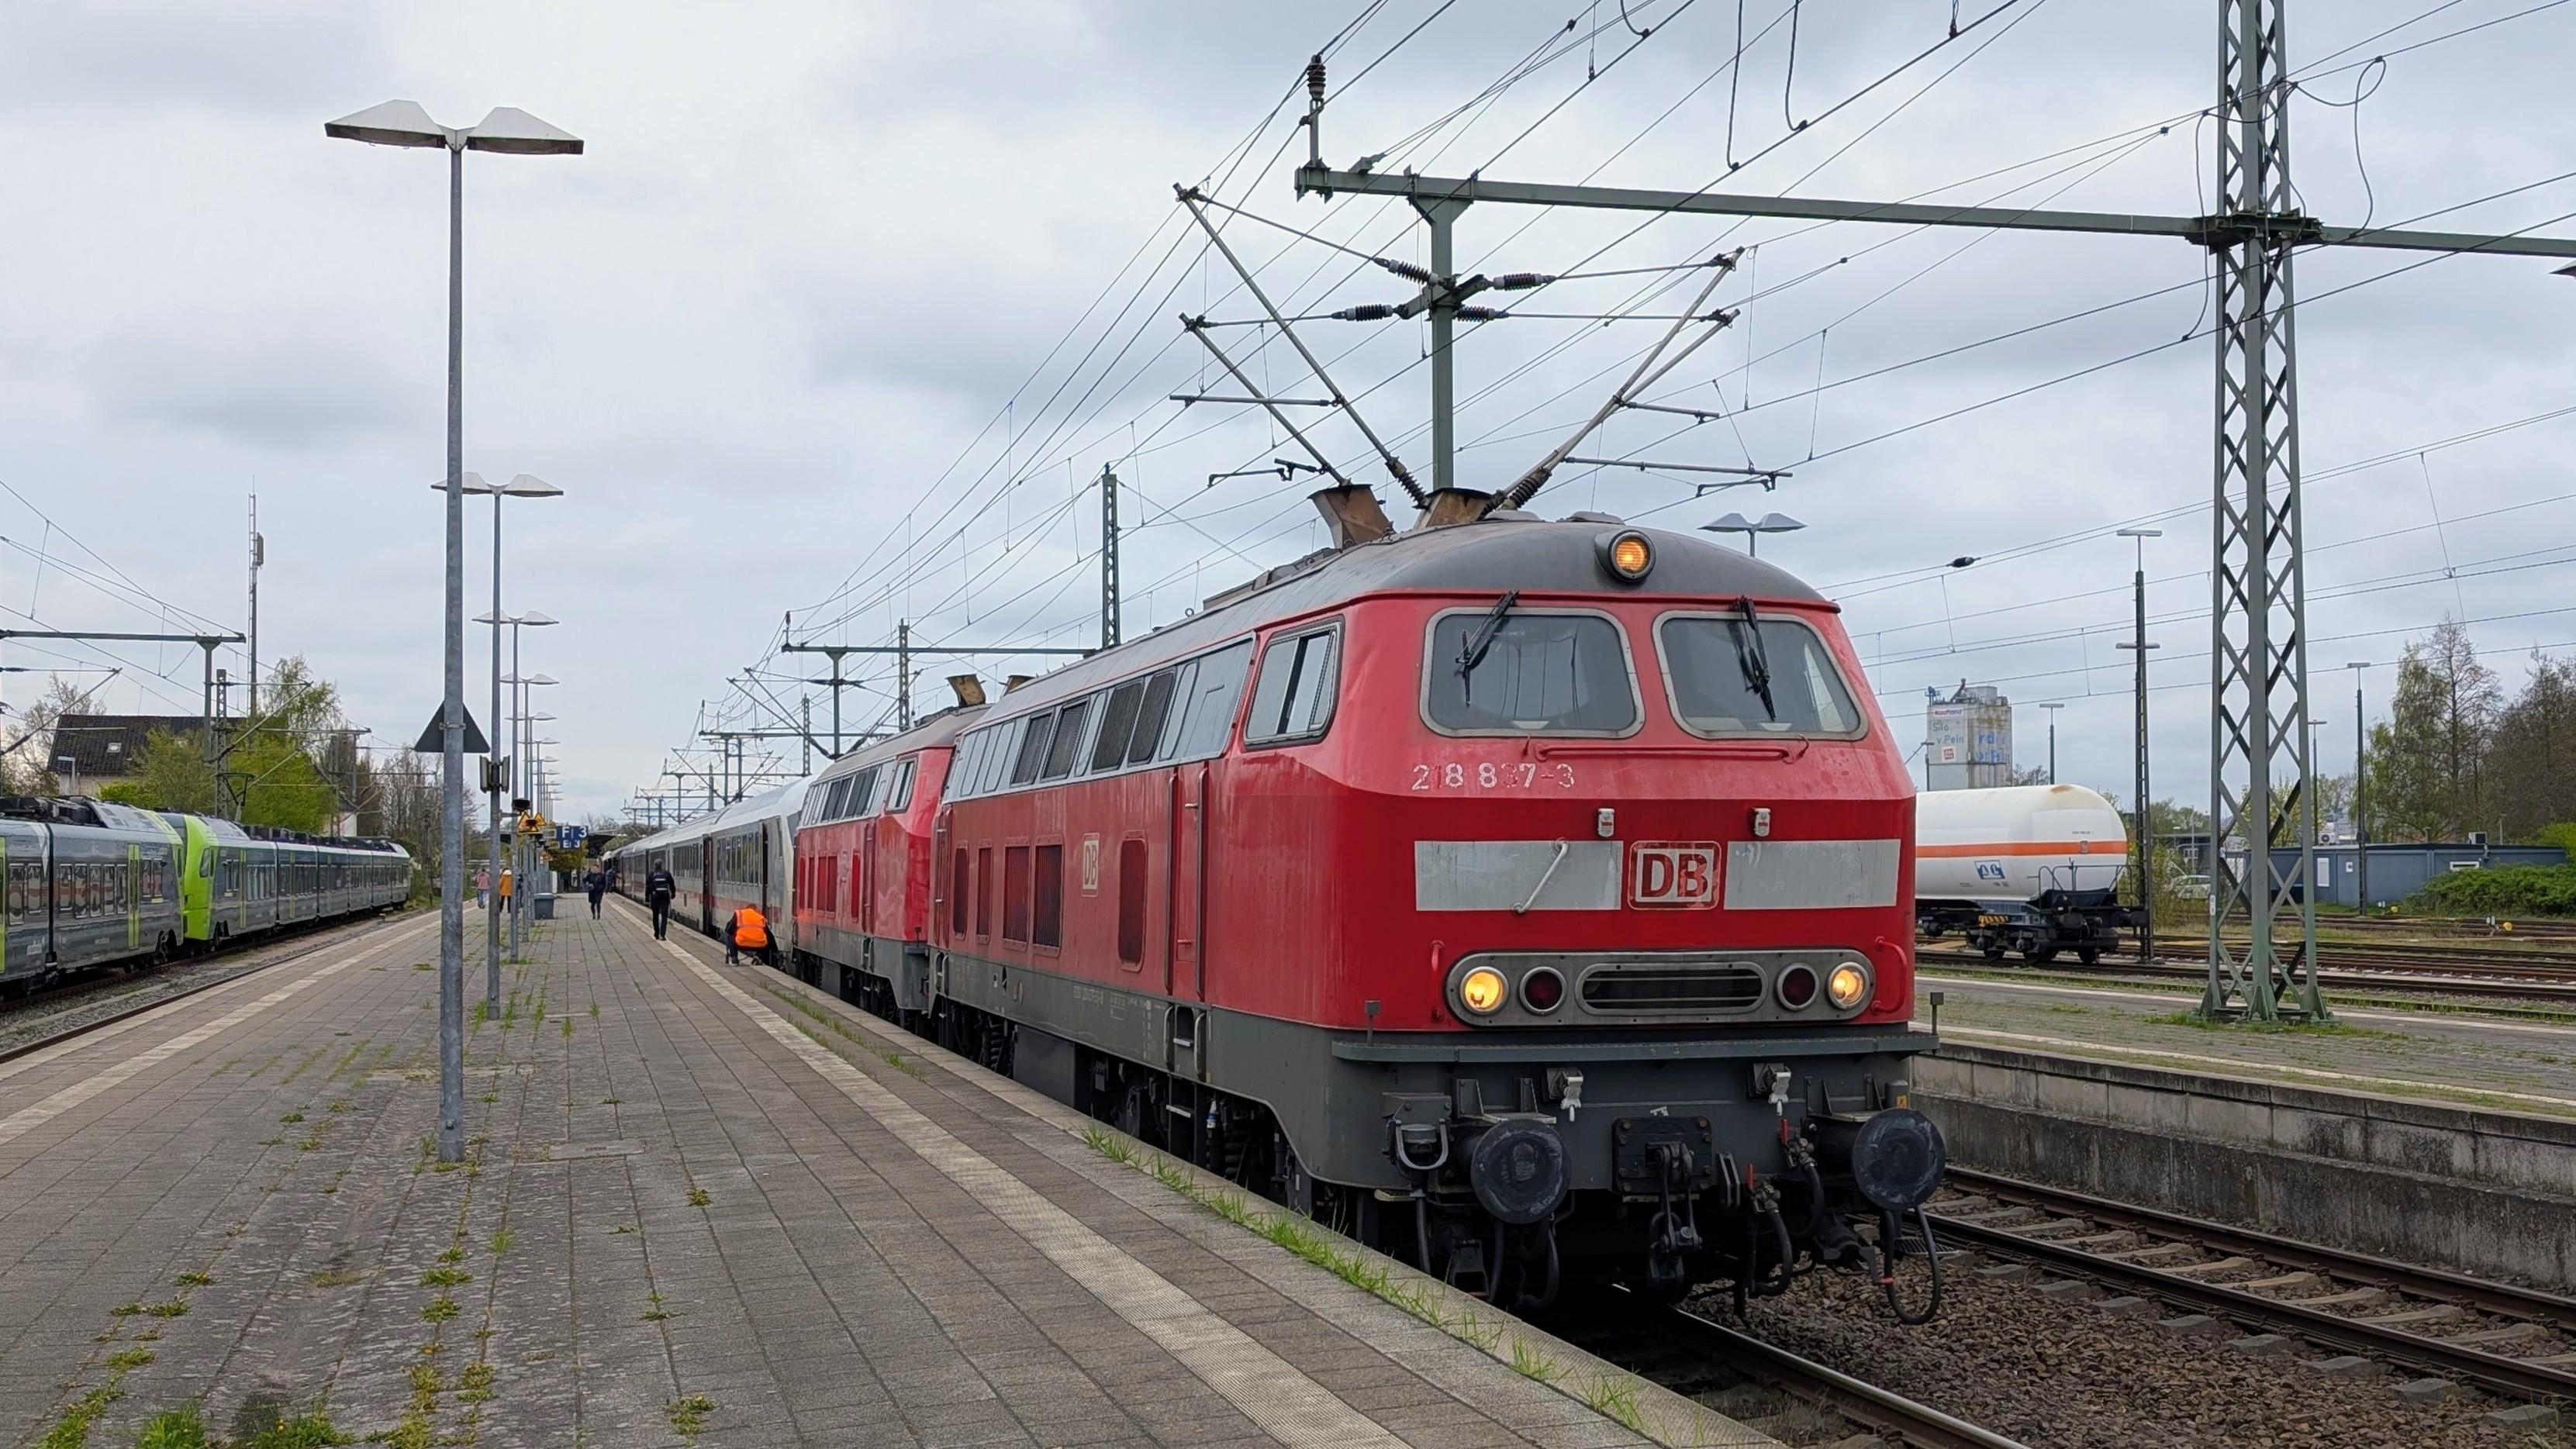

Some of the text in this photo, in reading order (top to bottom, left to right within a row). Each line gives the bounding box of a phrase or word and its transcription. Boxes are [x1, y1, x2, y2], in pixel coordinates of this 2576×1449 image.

[1932, 723, 1949, 732] Silo
[1412, 763, 1464, 791] 218
[562, 826, 587, 838] F 3
[563, 840, 581, 848] E 3
[1085, 844, 1097, 885] DB
[1641, 854, 1708, 897] DB
